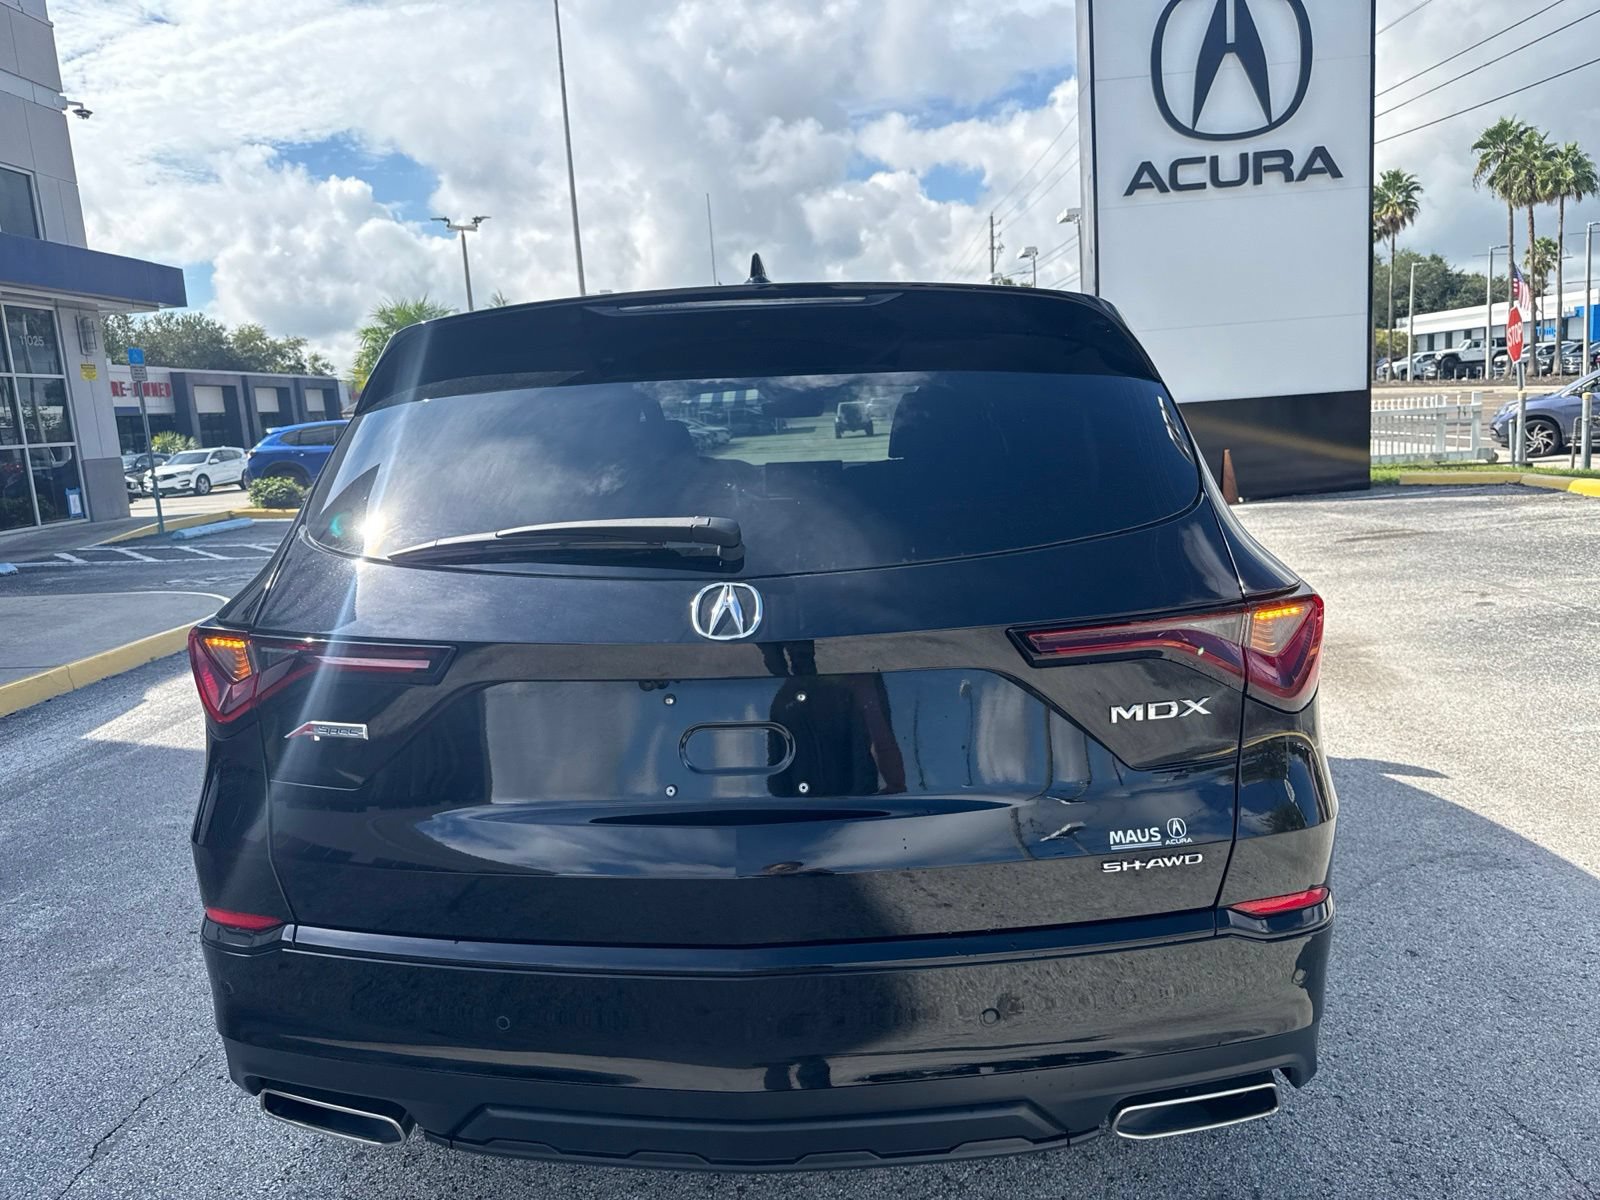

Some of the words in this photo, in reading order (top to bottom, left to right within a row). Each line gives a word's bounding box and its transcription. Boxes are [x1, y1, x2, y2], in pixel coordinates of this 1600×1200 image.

[1123, 146, 1344, 196] ACURA
[19, 336, 45, 346] 11025
[1508, 322, 1521, 347] STOP
[1110, 697, 1212, 724] MDX
[1109, 827, 1161, 844] MAUS
[1165, 837, 1193, 845] ACURA
[1102, 853, 1203, 873] SH-AWD
